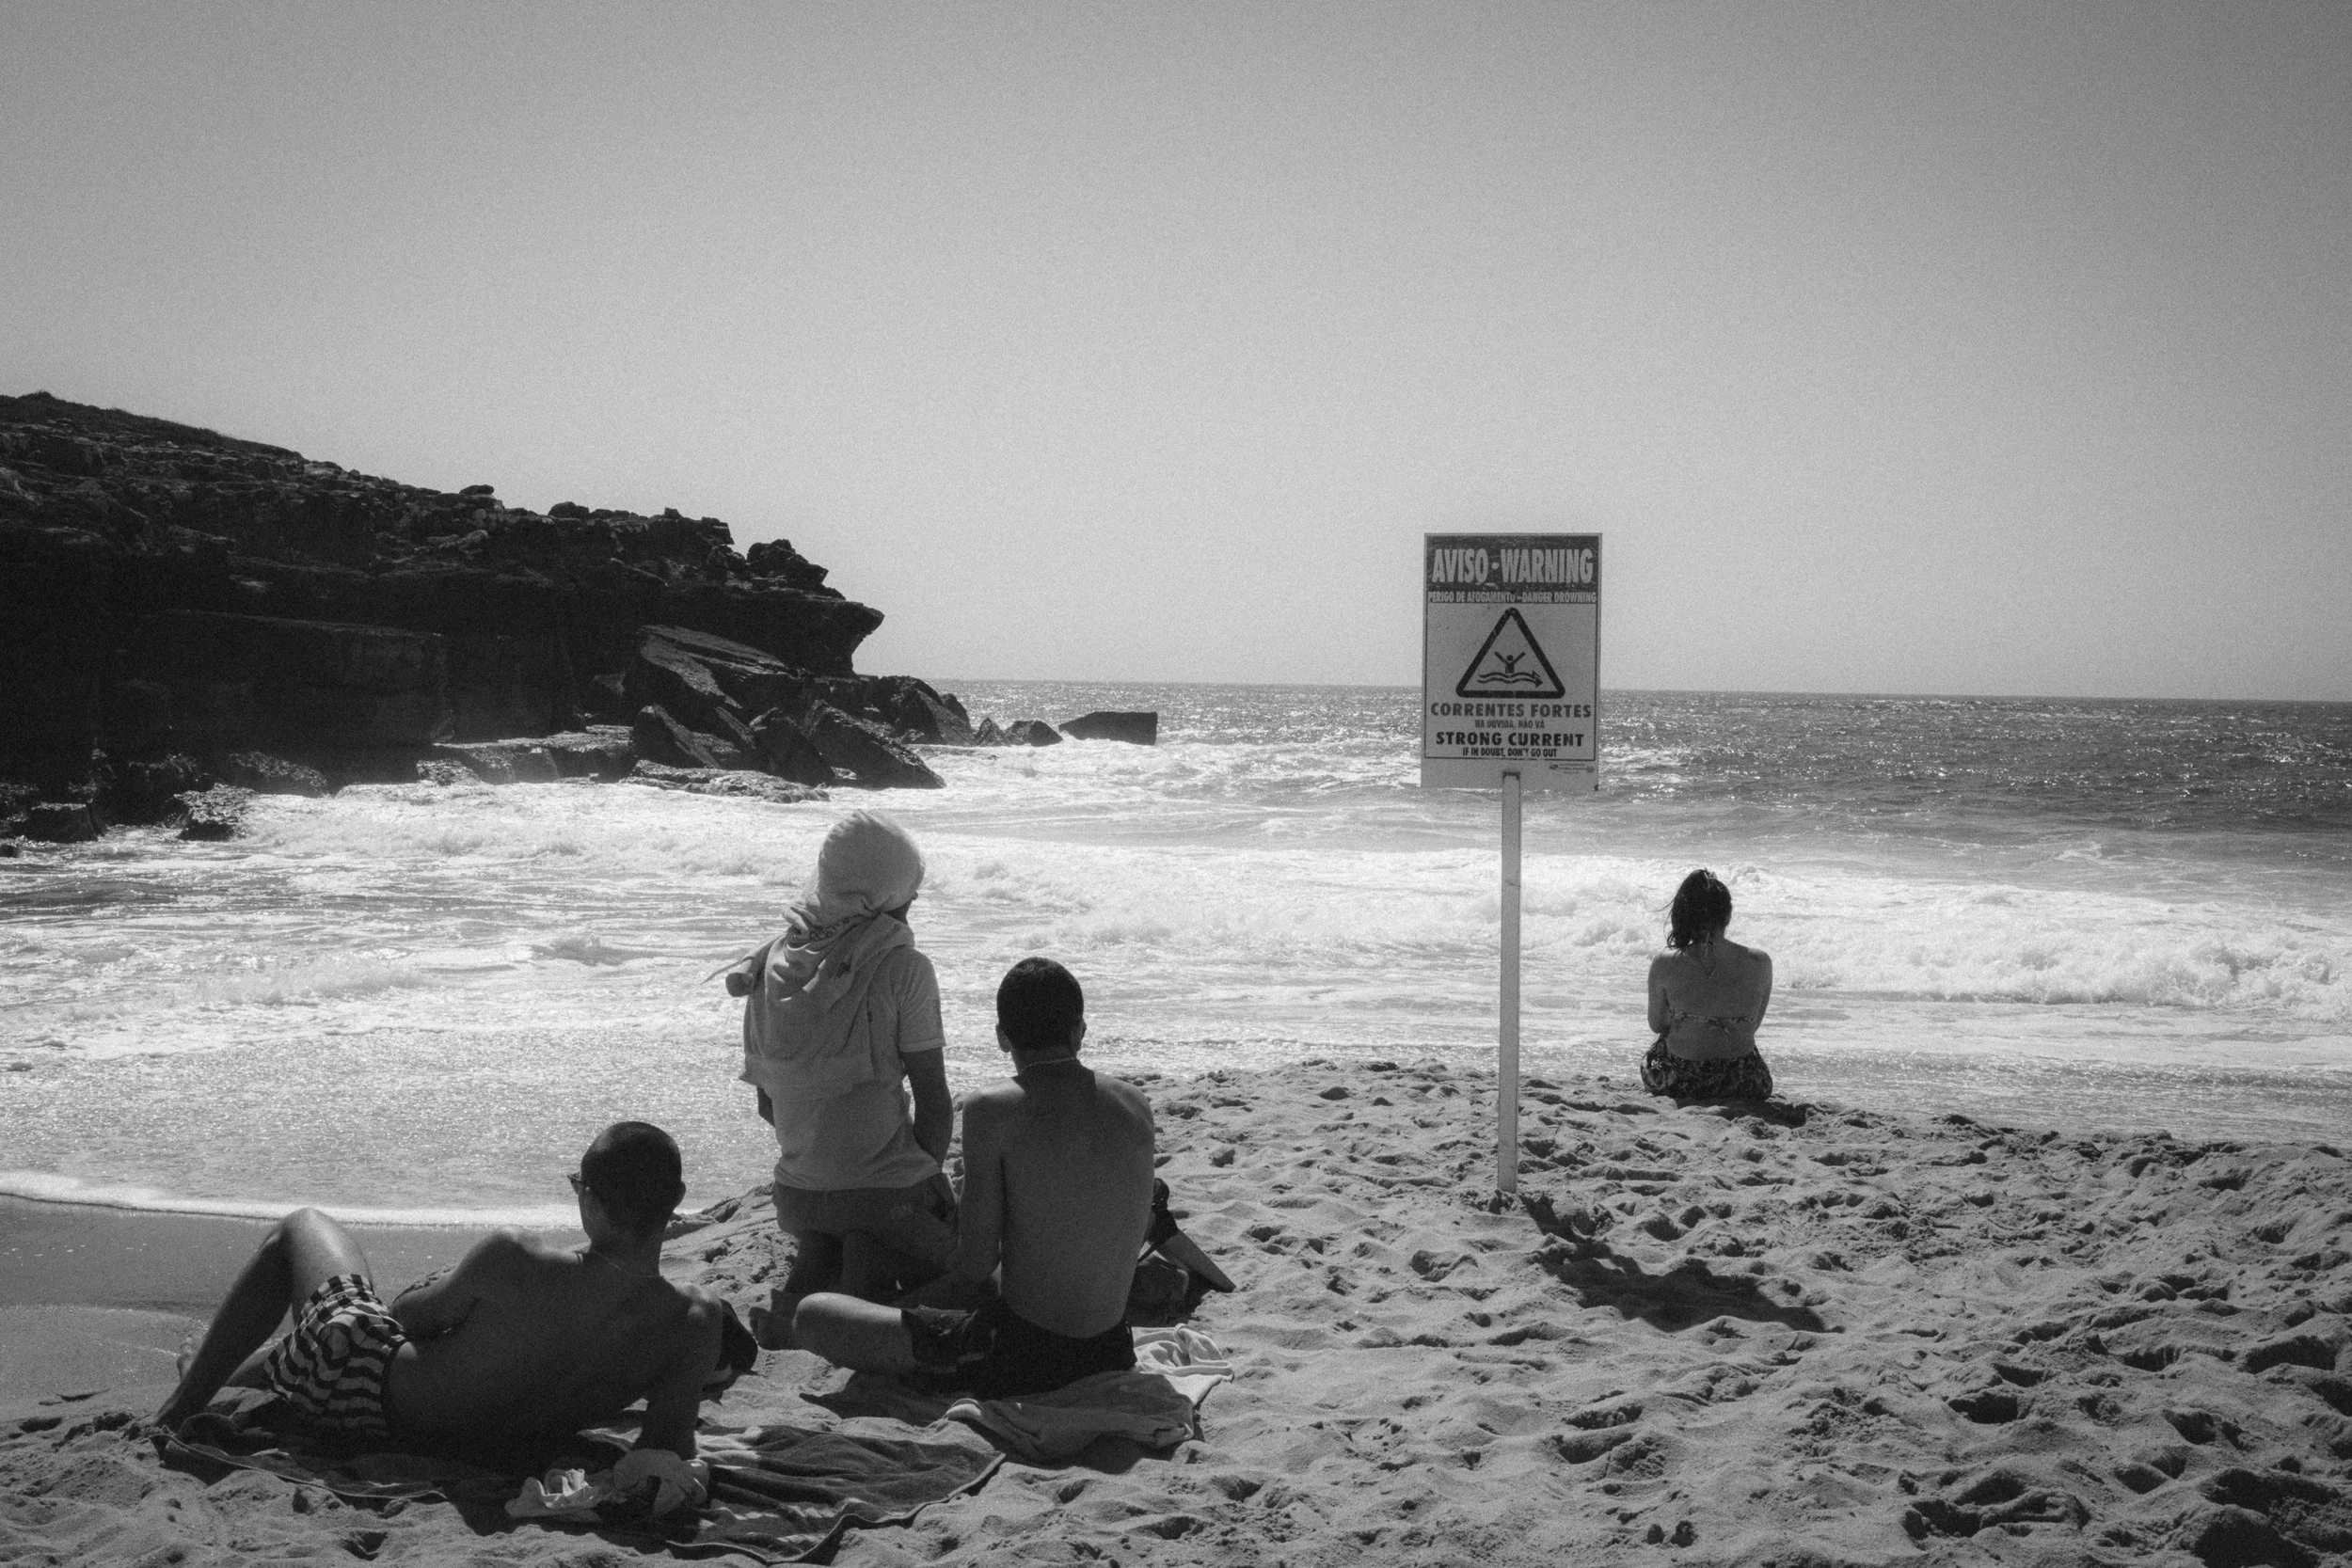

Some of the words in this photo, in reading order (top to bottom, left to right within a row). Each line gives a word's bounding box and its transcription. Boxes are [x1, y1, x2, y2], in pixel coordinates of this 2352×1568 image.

[1432, 548, 1488, 583] AVISO
[1501, 548, 1594, 583] WARNING
[1428, 591, 1454, 603] PERIGO
[1455, 592, 1466, 603] DE
[1522, 592, 1552, 603] DANGER
[1553, 592, 1597, 603] DROWNING
[1430, 703, 1525, 717] CORRENTES
[1531, 704, 1592, 718] FORTES
[1436, 732, 1502, 746] STRONG
[1508, 733, 1584, 747] CURRENT
[1462, 747, 1470, 756] IF
[1470, 747, 1479, 756] IN
[1507, 748, 1530, 757] DON'T
[1531, 749, 1541, 757] GO
[1543, 749, 1558, 757] OUT
